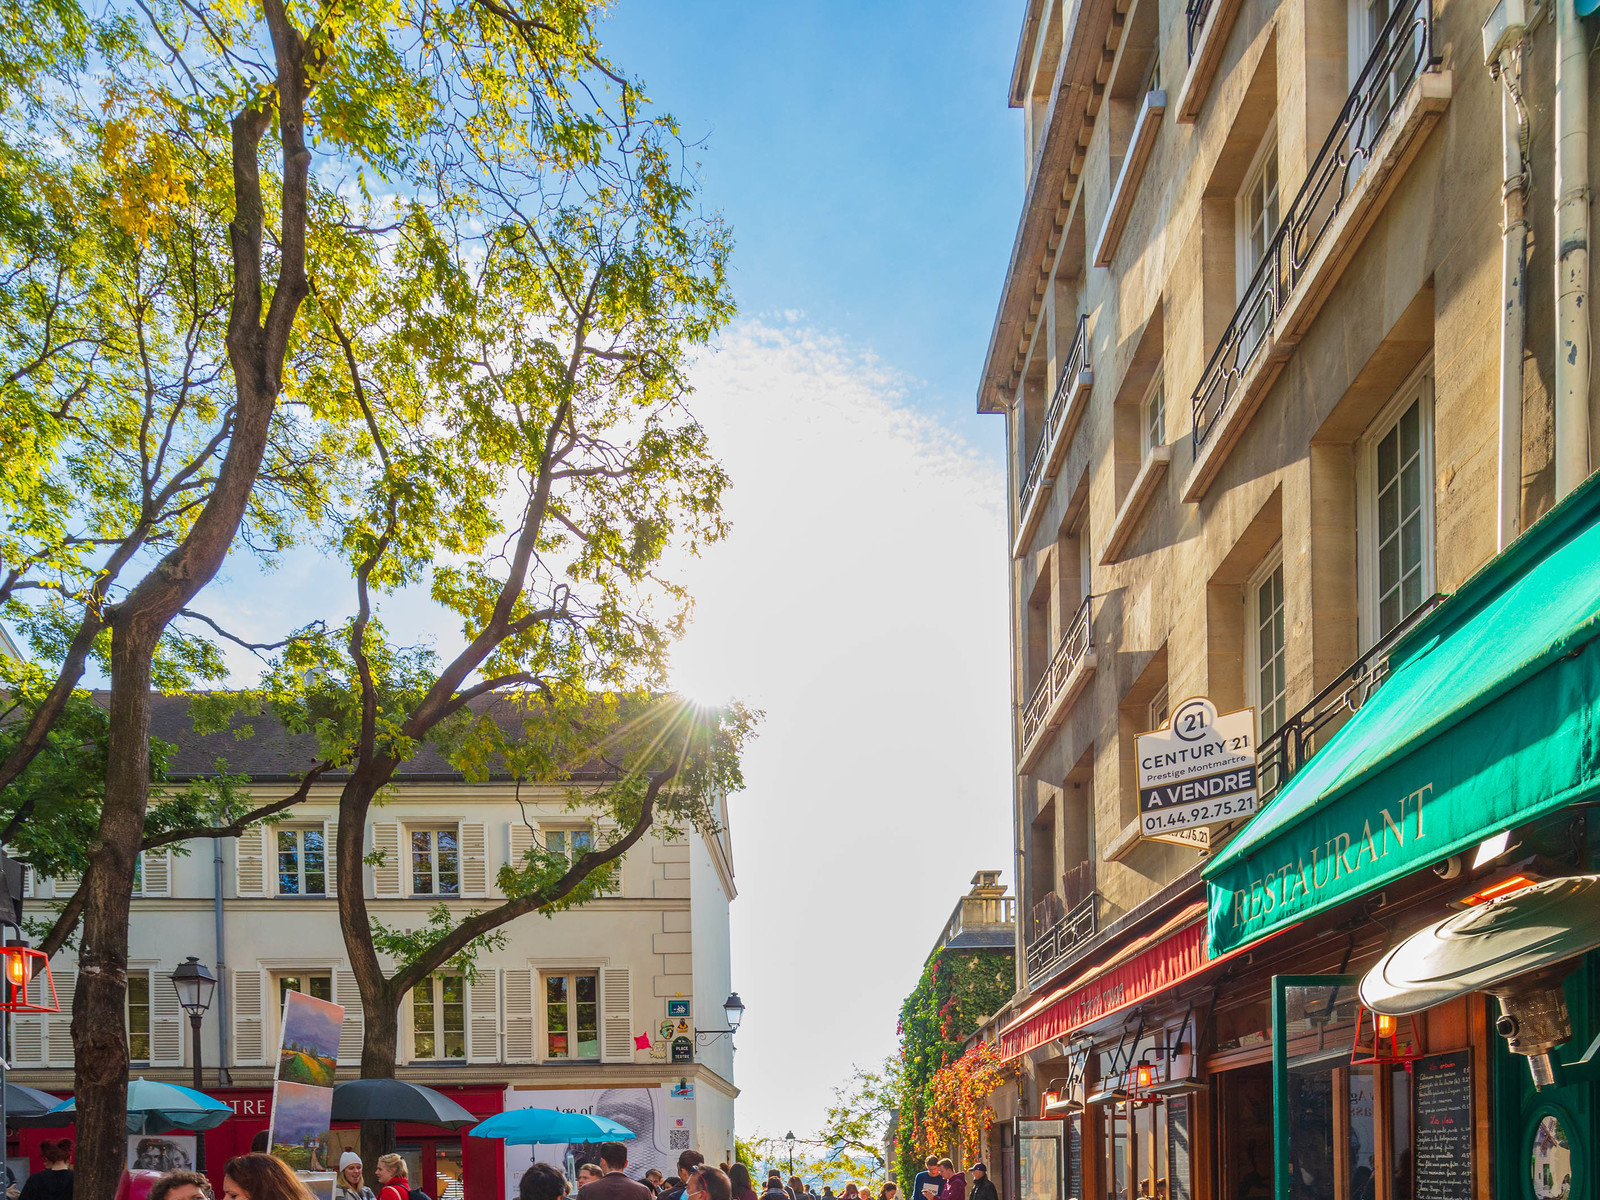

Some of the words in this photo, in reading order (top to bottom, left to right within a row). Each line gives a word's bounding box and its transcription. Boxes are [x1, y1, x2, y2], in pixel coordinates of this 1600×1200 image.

[1184, 711, 1205, 733] 21
[1142, 740, 1227, 770] CENTURY
[1232, 735, 1249, 751] 21
[1147, 766, 1186, 782] Prestige
[1187, 755, 1247, 774] Montmartre
[1147, 791, 1163, 808] A
[1166, 771, 1252, 803] VENDRE
[1145, 797, 1254, 830] 01.44.92.75.21
[1232, 782, 1433, 929] RESTAURANT
[220, 1100, 266, 1115] TRE
